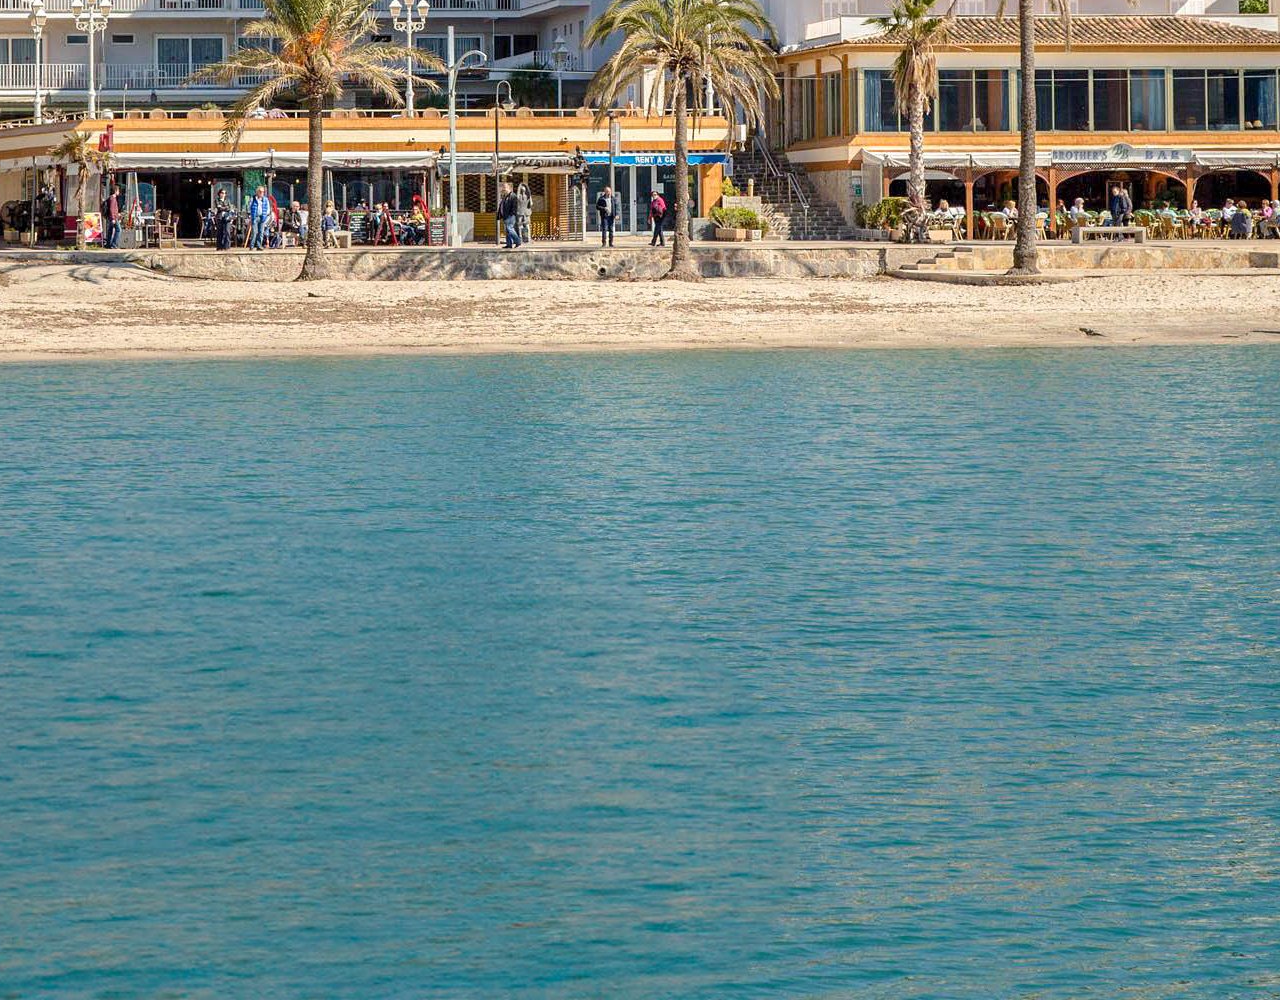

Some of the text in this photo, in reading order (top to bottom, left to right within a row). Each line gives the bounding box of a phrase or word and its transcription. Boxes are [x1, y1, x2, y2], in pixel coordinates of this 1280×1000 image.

[635, 156, 654, 164] RENT
[657, 156, 663, 164] A
[1052, 149, 1181, 161] BROTHER'S BAR
